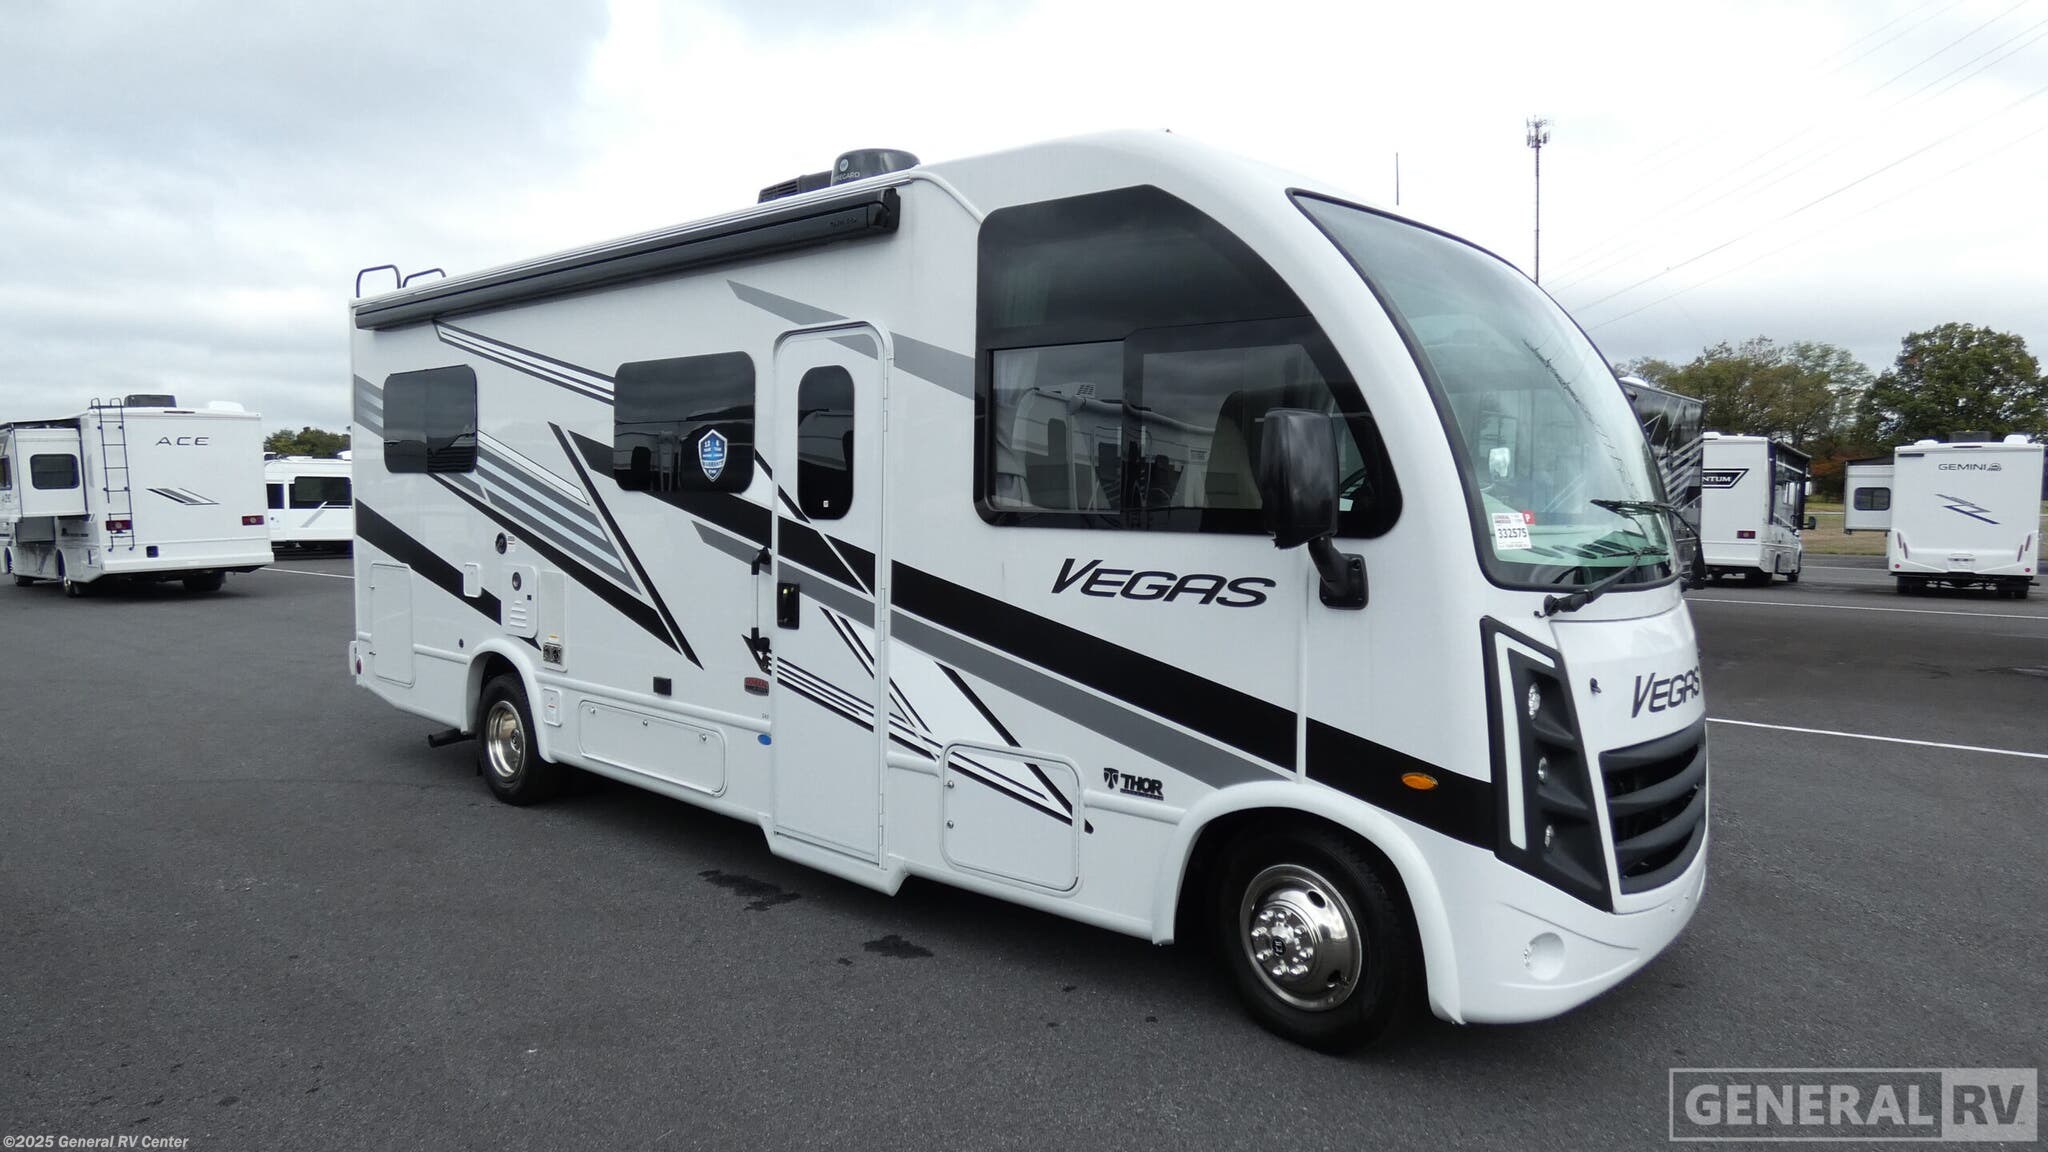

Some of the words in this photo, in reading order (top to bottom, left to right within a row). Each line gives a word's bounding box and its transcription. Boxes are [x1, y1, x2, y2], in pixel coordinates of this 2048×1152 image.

[155, 436, 210, 446] ACE
[1938, 463, 1986, 471] GEMINI
[1497, 528, 1528, 538] 332575
[1050, 558, 1277, 608] VEGAS
[1631, 665, 1700, 718] VEGAS
[1120, 773, 1163, 796] THOR
